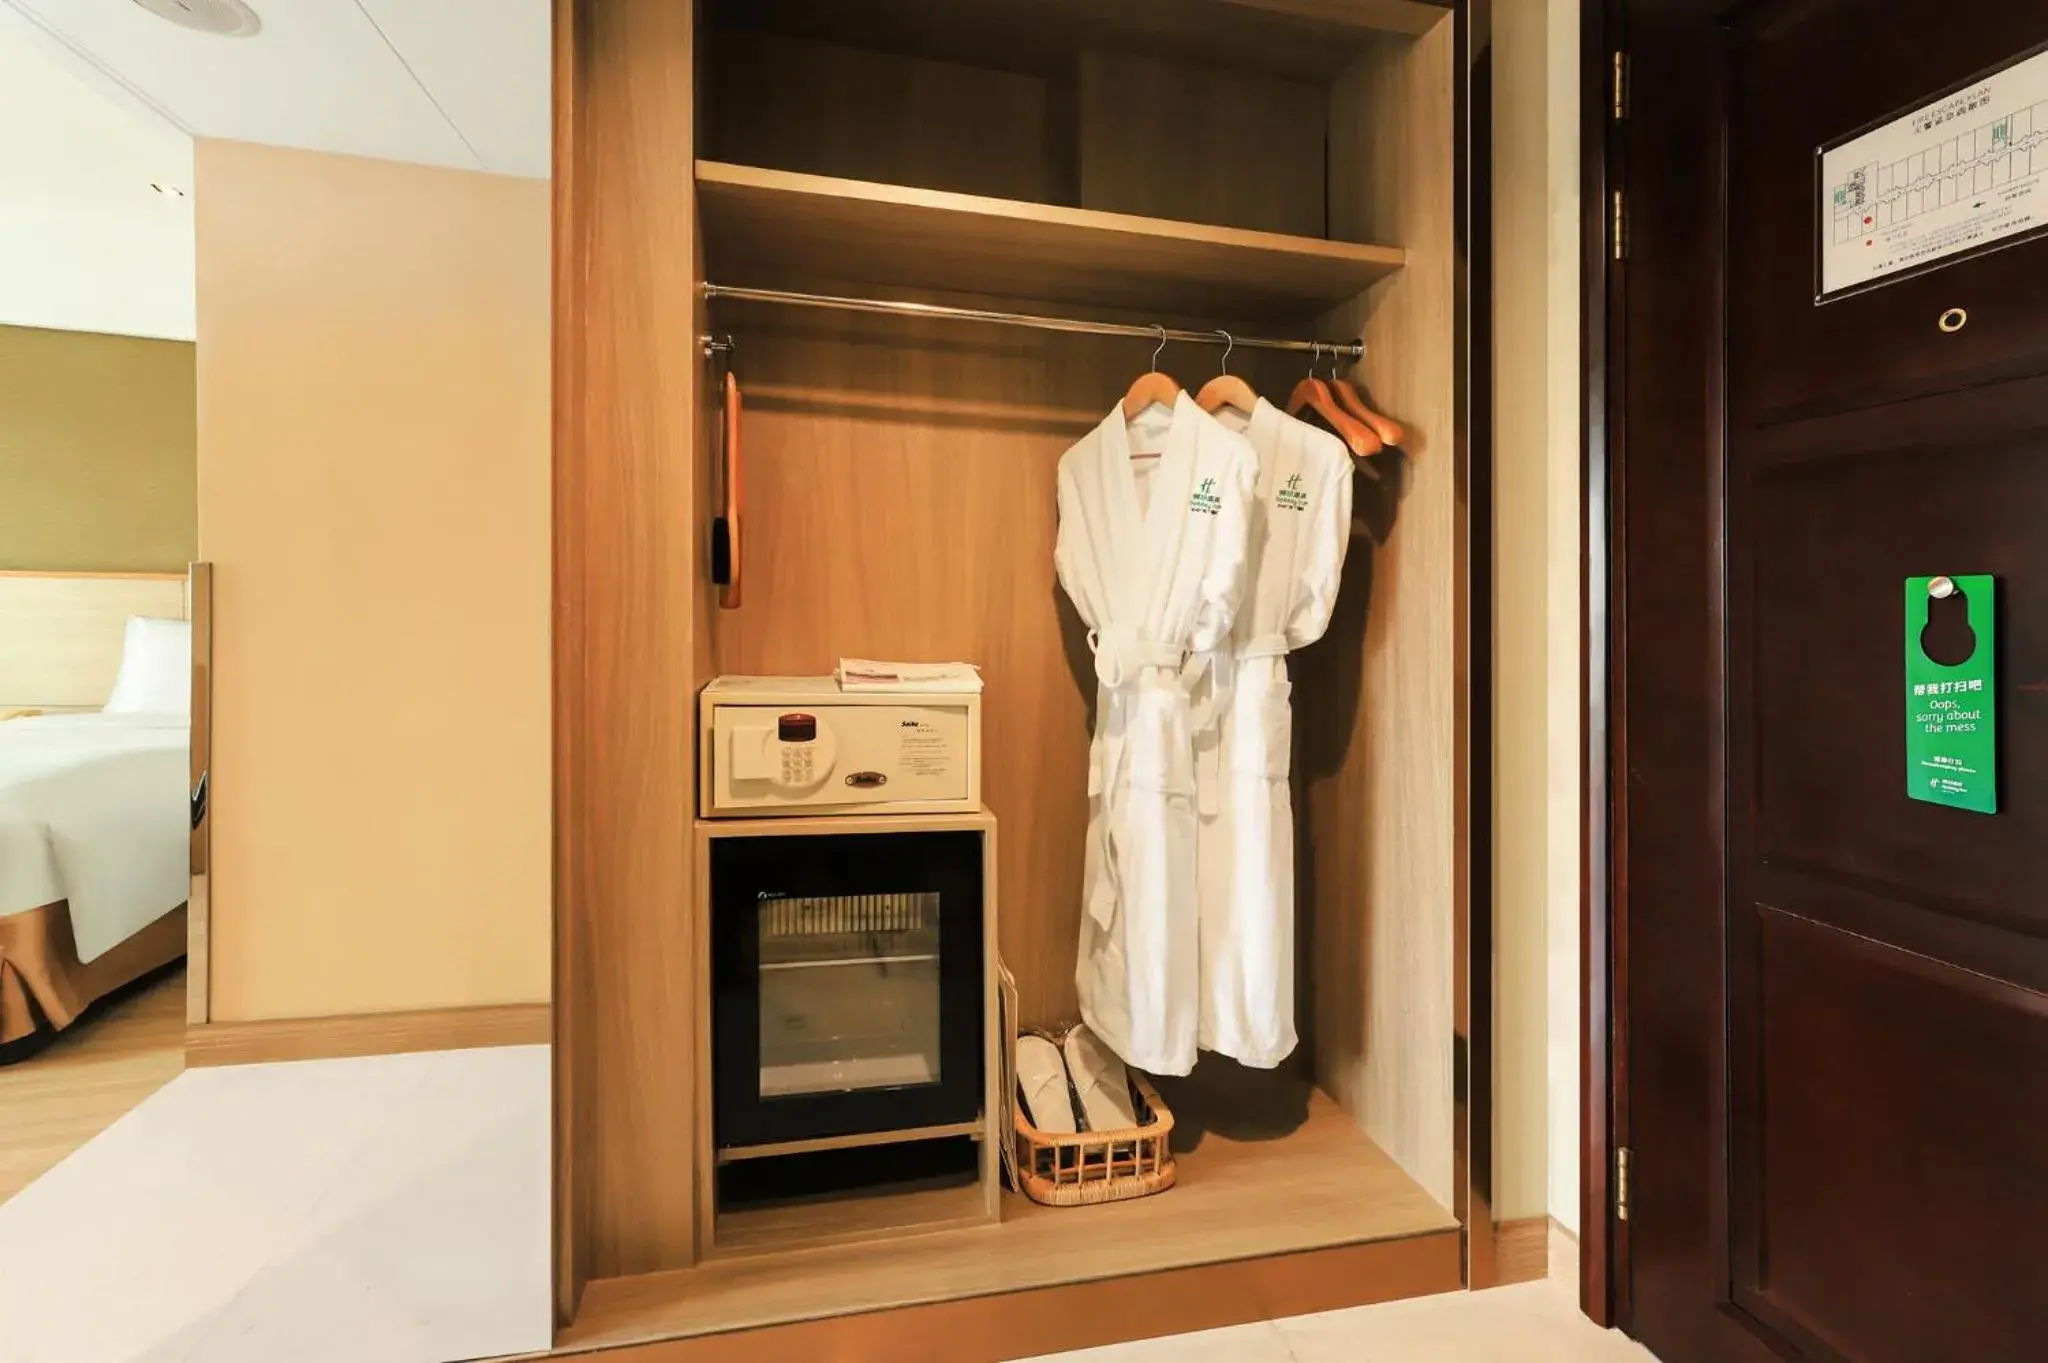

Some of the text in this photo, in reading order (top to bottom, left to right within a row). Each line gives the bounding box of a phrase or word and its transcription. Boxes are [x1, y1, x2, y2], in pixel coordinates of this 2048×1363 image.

[1914, 679, 1982, 696] 帮我打扫吧
[1930, 699, 1960, 711] Oops,
[1916, 709, 1981, 723] sorry about
[1925, 723, 1976, 733] the mess
